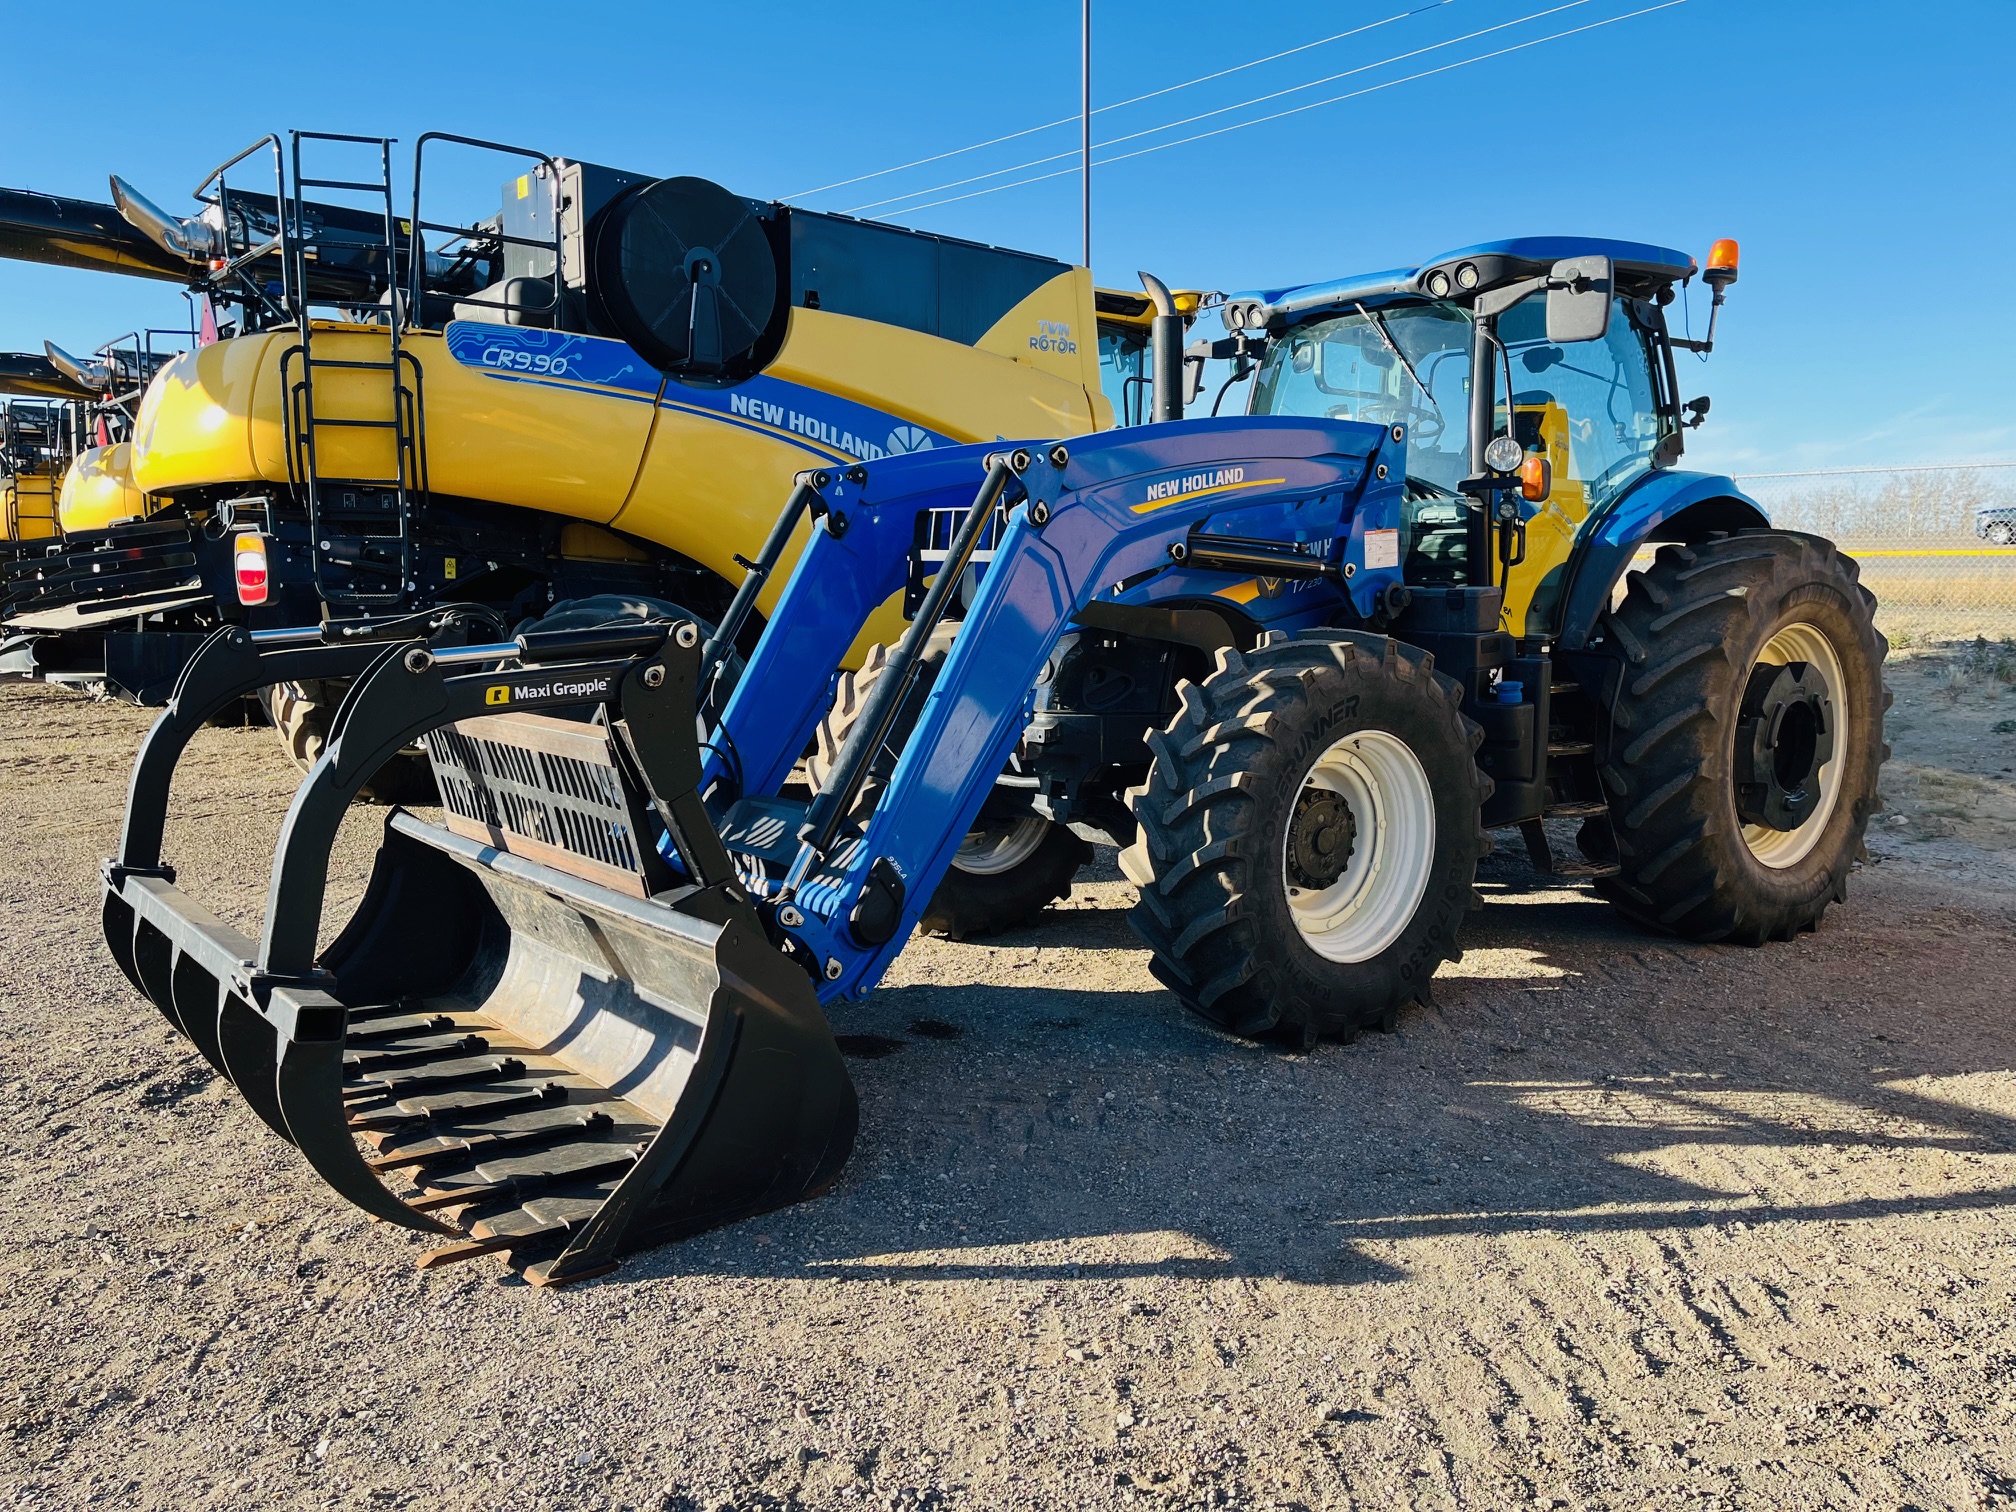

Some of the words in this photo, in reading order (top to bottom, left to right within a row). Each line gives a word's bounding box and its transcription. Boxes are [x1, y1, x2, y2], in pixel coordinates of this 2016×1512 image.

[1037, 319, 1070, 337] TWIN
[1029, 334, 1077, 355] ROTOR
[482, 347, 568, 375] CR9.90
[730, 393, 784, 426] NEW
[788, 410, 885, 462] HOLLAND
[1147, 478, 1180, 502] NEW
[1182, 467, 1244, 494] HOLLAND
[514, 683, 551, 700] Maxi
